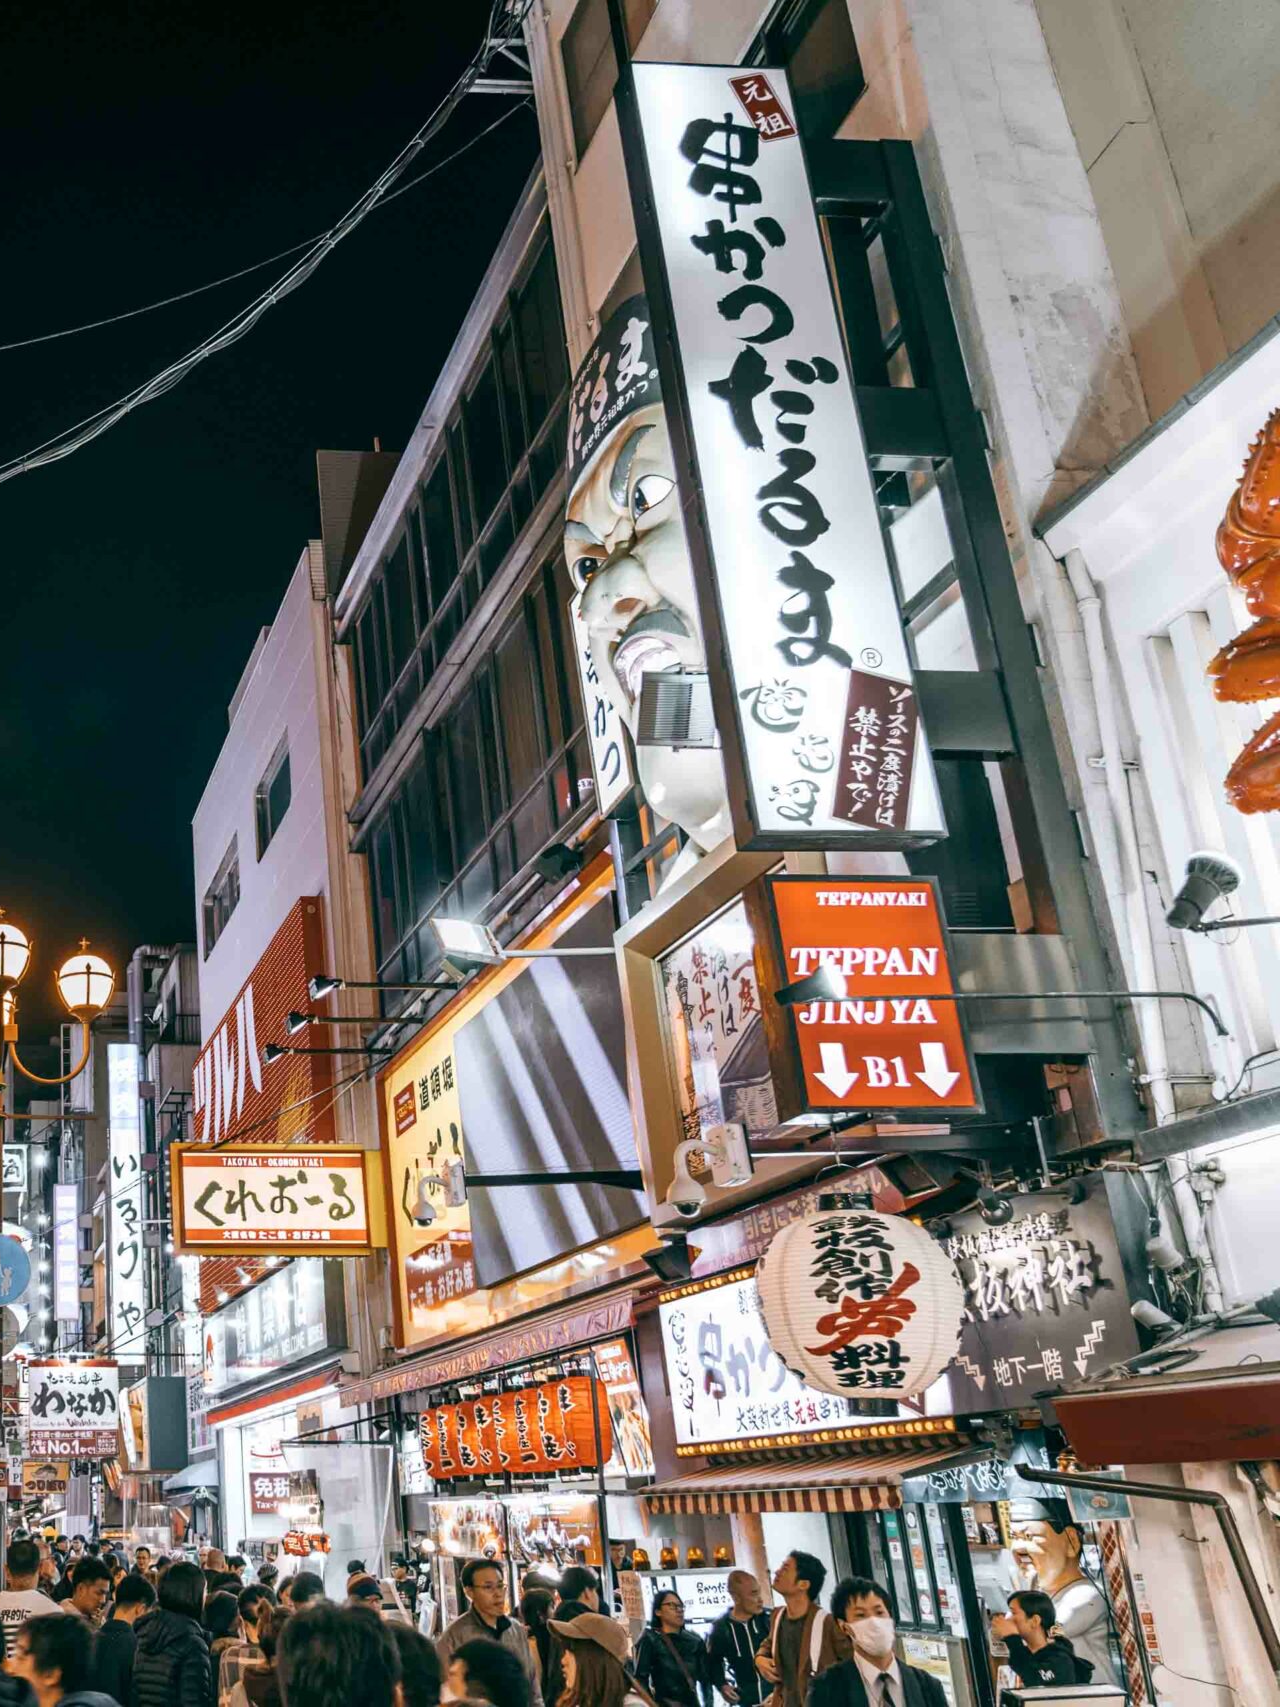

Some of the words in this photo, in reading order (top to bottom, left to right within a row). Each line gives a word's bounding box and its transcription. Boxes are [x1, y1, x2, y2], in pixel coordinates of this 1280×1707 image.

[742, 78, 791, 136] 元祖
[678, 112, 854, 670] 串かつだるま
[846, 706, 883, 818] 禁止やで!
[875, 686, 913, 828] ソースの二度漬けは
[816, 891, 927, 907] TEPPANYAKI
[791, 947, 939, 977] TEPPAN
[798, 999, 937, 1025] JINJYA
[862, 1055, 912, 1087] B1
[194, 1170, 356, 1227] くれおーる
[964, 1239, 1093, 1323] 板神社
[993, 1348, 1064, 1387] 地下一階
[31, 1382, 116, 1418] わなか
[48, 1439, 80, 1455] No.1
